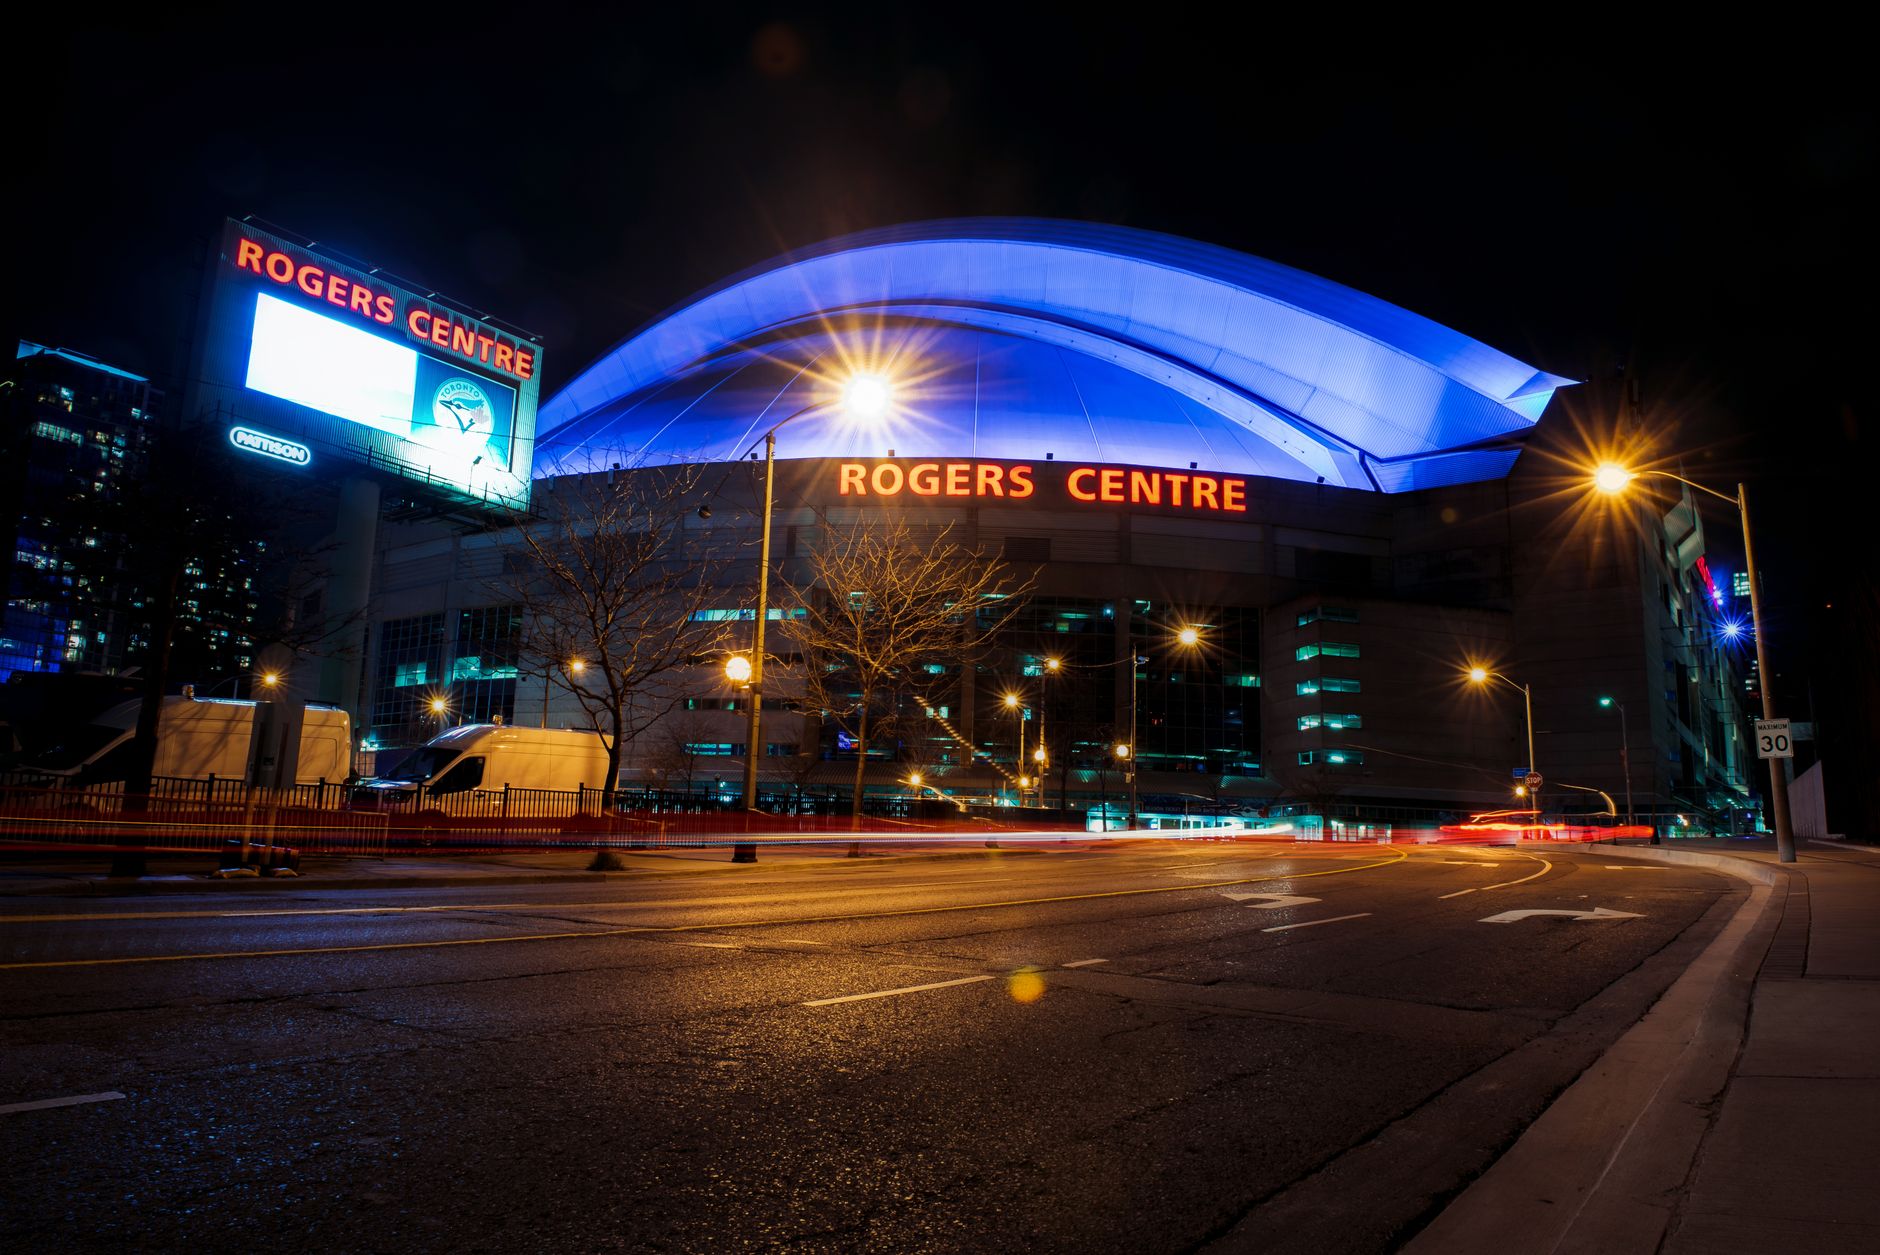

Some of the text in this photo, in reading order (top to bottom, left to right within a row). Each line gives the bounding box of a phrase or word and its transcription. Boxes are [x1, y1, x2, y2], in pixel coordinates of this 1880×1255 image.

[237, 238, 533, 380] ROGERS CENTRE
[441, 383, 480, 398] TORONTO
[236, 431, 305, 461] PATTISON
[839, 463, 1247, 512] ROGERS CENTRE
[1761, 735, 1788, 752] 30
[1526, 776, 1541, 784] STOP
